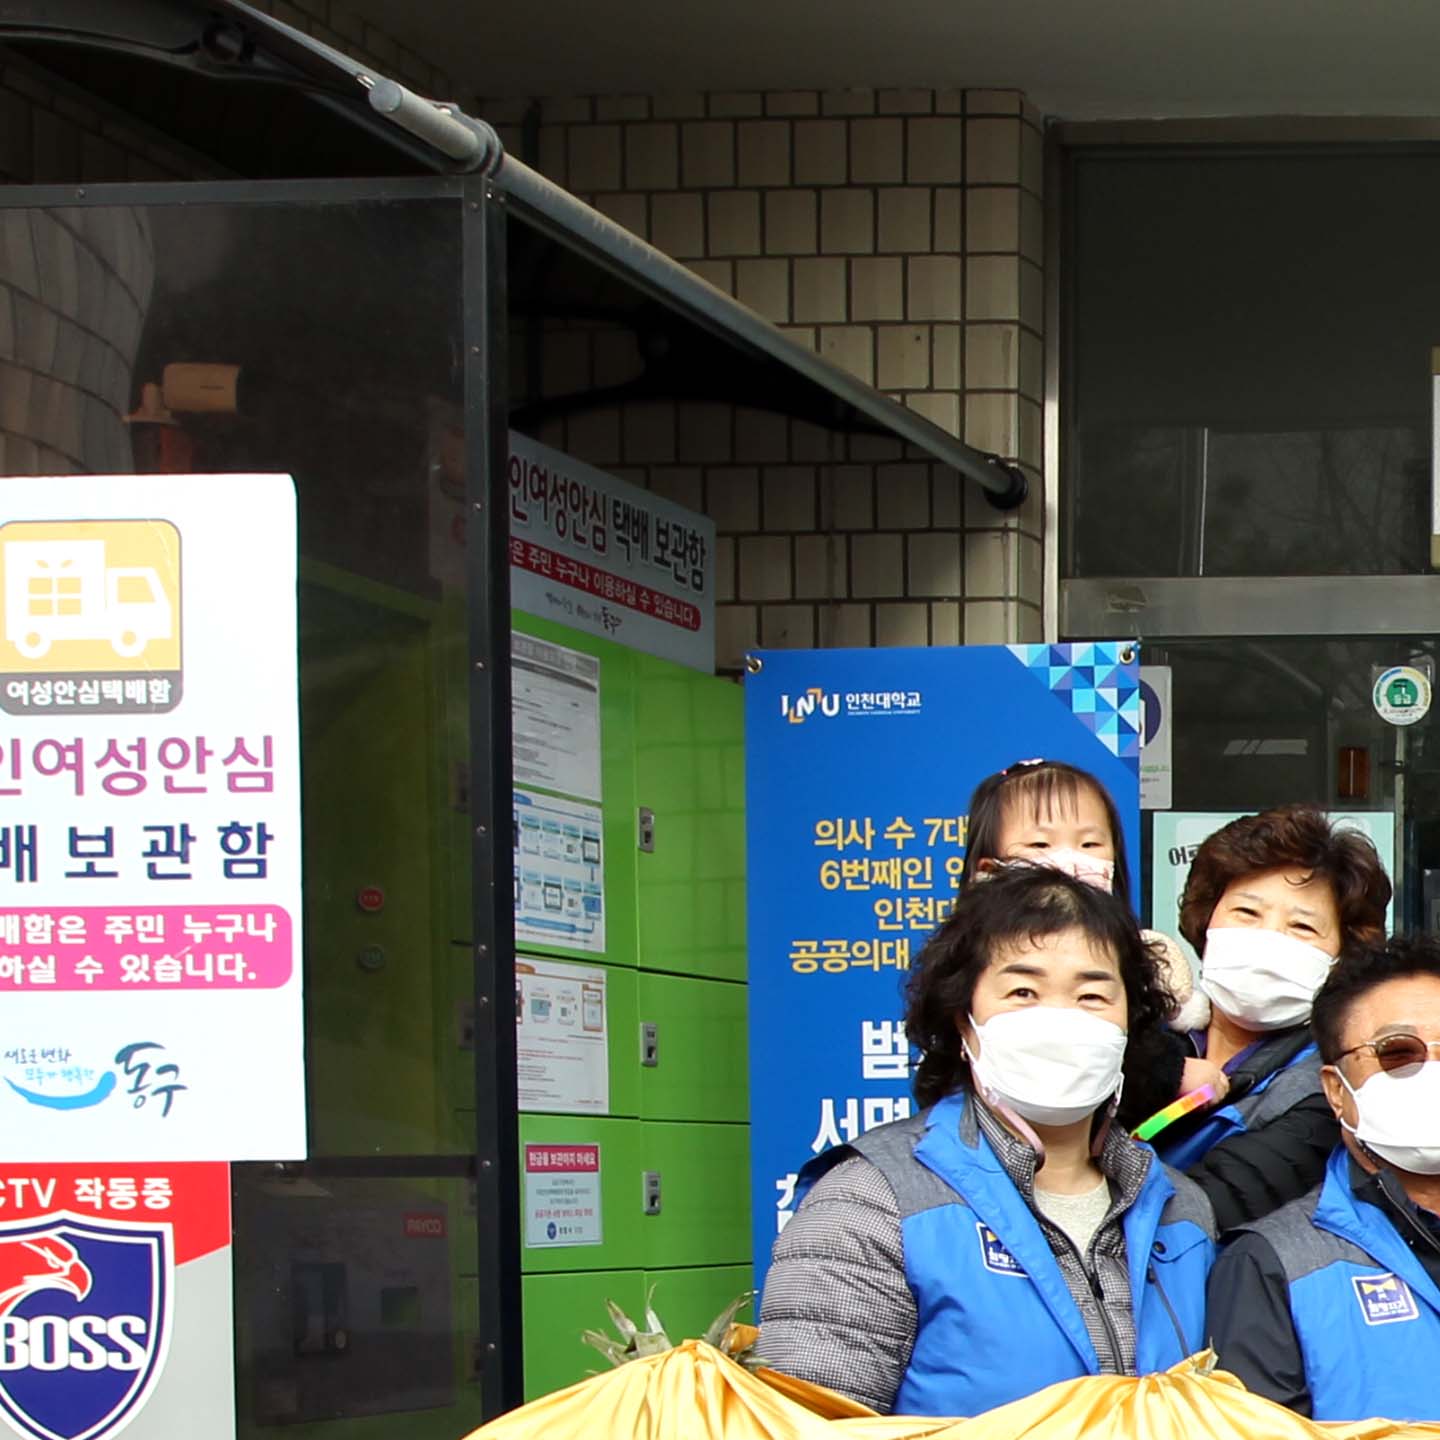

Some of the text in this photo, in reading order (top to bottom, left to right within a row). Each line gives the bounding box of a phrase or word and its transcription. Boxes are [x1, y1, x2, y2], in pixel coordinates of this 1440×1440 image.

[611, 498, 650, 566] 택배
[653, 513, 707, 596] 보관함
[6, 679, 172, 705] 여성안심택배함
[845, 692, 922, 710] 인천대학교
[813, 816, 876, 852] 의사
[883, 817, 917, 850] 수
[819, 855, 934, 893] 6번째인
[104, 915, 164, 944] 주민
[183, 913, 277, 943] 누구나
[74, 955, 104, 984] 수
[120, 953, 256, 982] 있습니다.
[788, 938, 911, 975] 공공의대
[114, 1041, 188, 1118] 동구
[0, 1174, 176, 1212] TV 작동중
